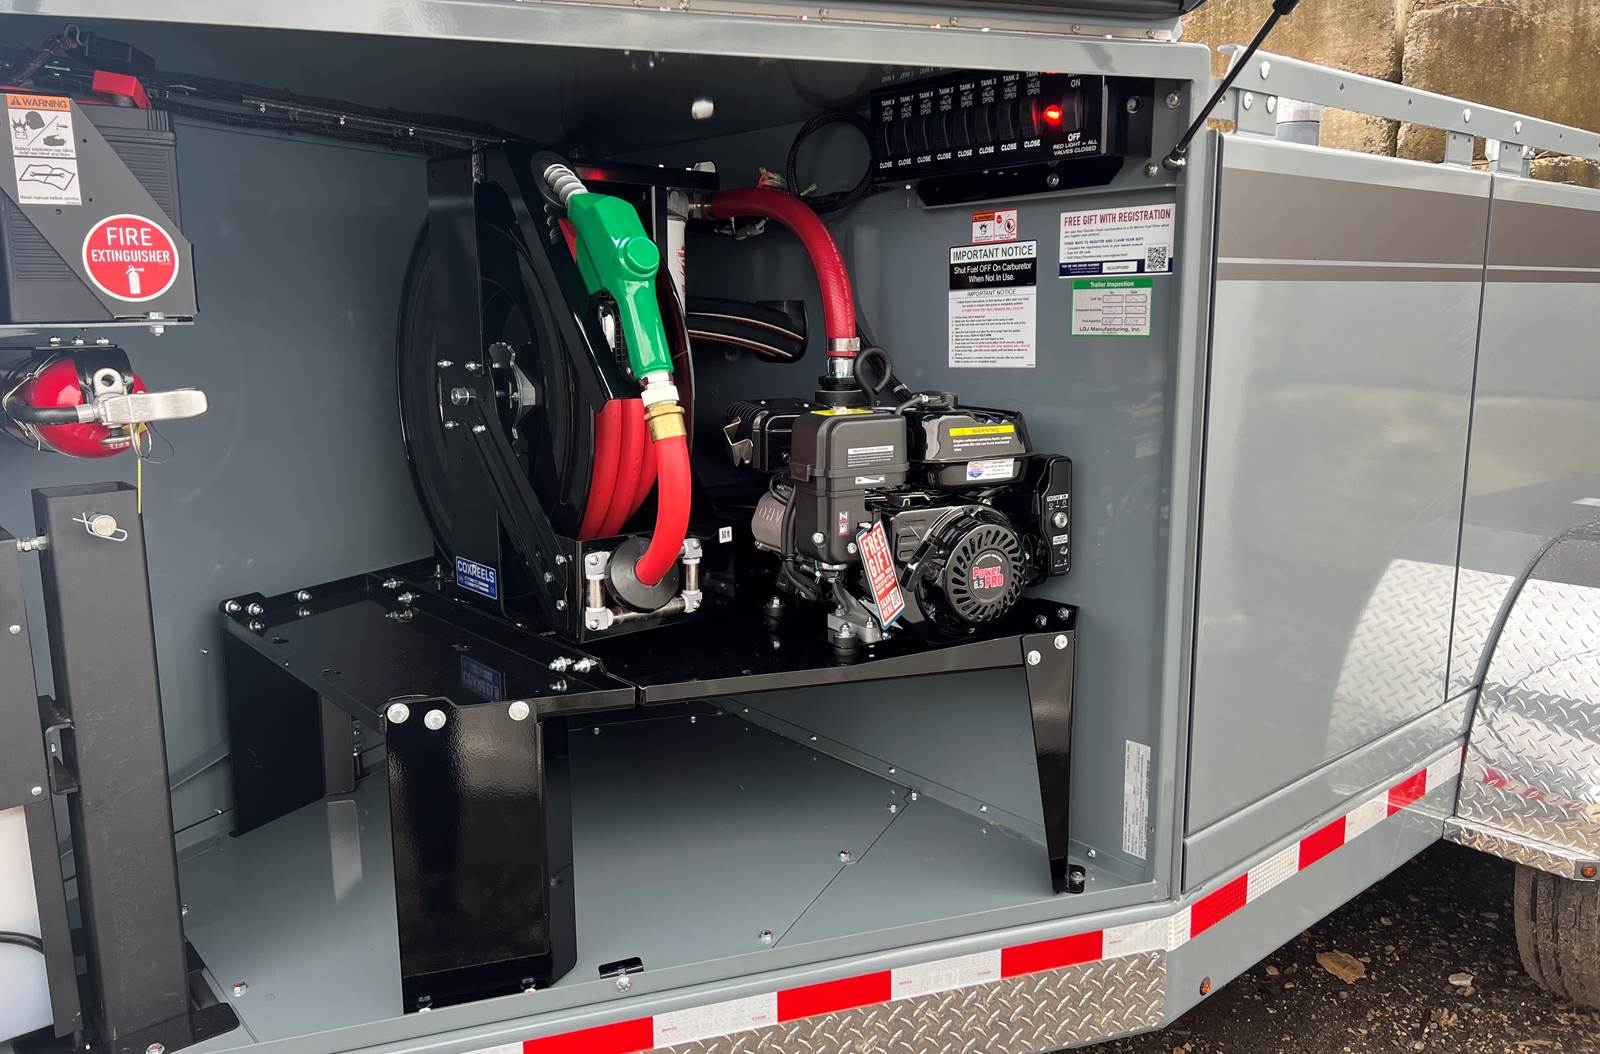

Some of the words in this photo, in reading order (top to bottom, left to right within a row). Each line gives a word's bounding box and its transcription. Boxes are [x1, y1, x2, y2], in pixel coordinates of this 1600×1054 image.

[1003, 74, 1015, 82] TANK
[959, 83, 971, 91] TANK
[1070, 79, 1080, 88] ON
[23, 98, 68, 109] WARNING
[1067, 132, 1080, 142] OFF
[1001, 142, 1017, 151] CLOSE
[1024, 139, 1040, 148] CLOSE
[1053, 142, 1064, 150] RED
[1065, 141, 1081, 149] LIGHT
[958, 149, 972, 157] CLOSE
[979, 145, 994, 154] CLOSE
[1053, 148, 1073, 156] VALVES
[1074, 145, 1097, 154] CLOSED
[917, 155, 931, 163] CLOSE
[937, 152, 951, 160] CLOSE
[880, 161, 892, 169] CLOSE
[898, 158, 911, 166] CLOSE
[1064, 215, 1081, 227] FREE
[1082, 214, 1098, 225] GIFT
[1099, 212, 1117, 224] WITH
[1118, 208, 1171, 222] REGISTRATION
[106, 227, 153, 246] FIRE
[91, 249, 170, 262] EXTINGUISHER
[953, 247, 999, 261] IMPORTANT
[1001, 245, 1033, 257] NOTICE
[954, 266, 966, 275] Shut
[967, 265, 979, 273] Fuel
[979, 264, 992, 272] OFF
[992, 263, 1001, 271] On
[1002, 262, 1032, 271] Carburetor
[968, 274, 984, 283] When
[985, 274, 995, 282] Not
[995, 273, 1001, 281] In
[1002, 273, 1015, 281] Use.
[967, 289, 996, 297] IMPORTANT
[863, 529, 886, 560] FREE
[868, 547, 891, 578] GIFT
[457, 560, 494, 583] COXREELS
[972, 566, 1001, 580] Power
[973, 580, 984, 589] 6.5
[985, 574, 1003, 589] PRO
[883, 602, 894, 617] HERE
